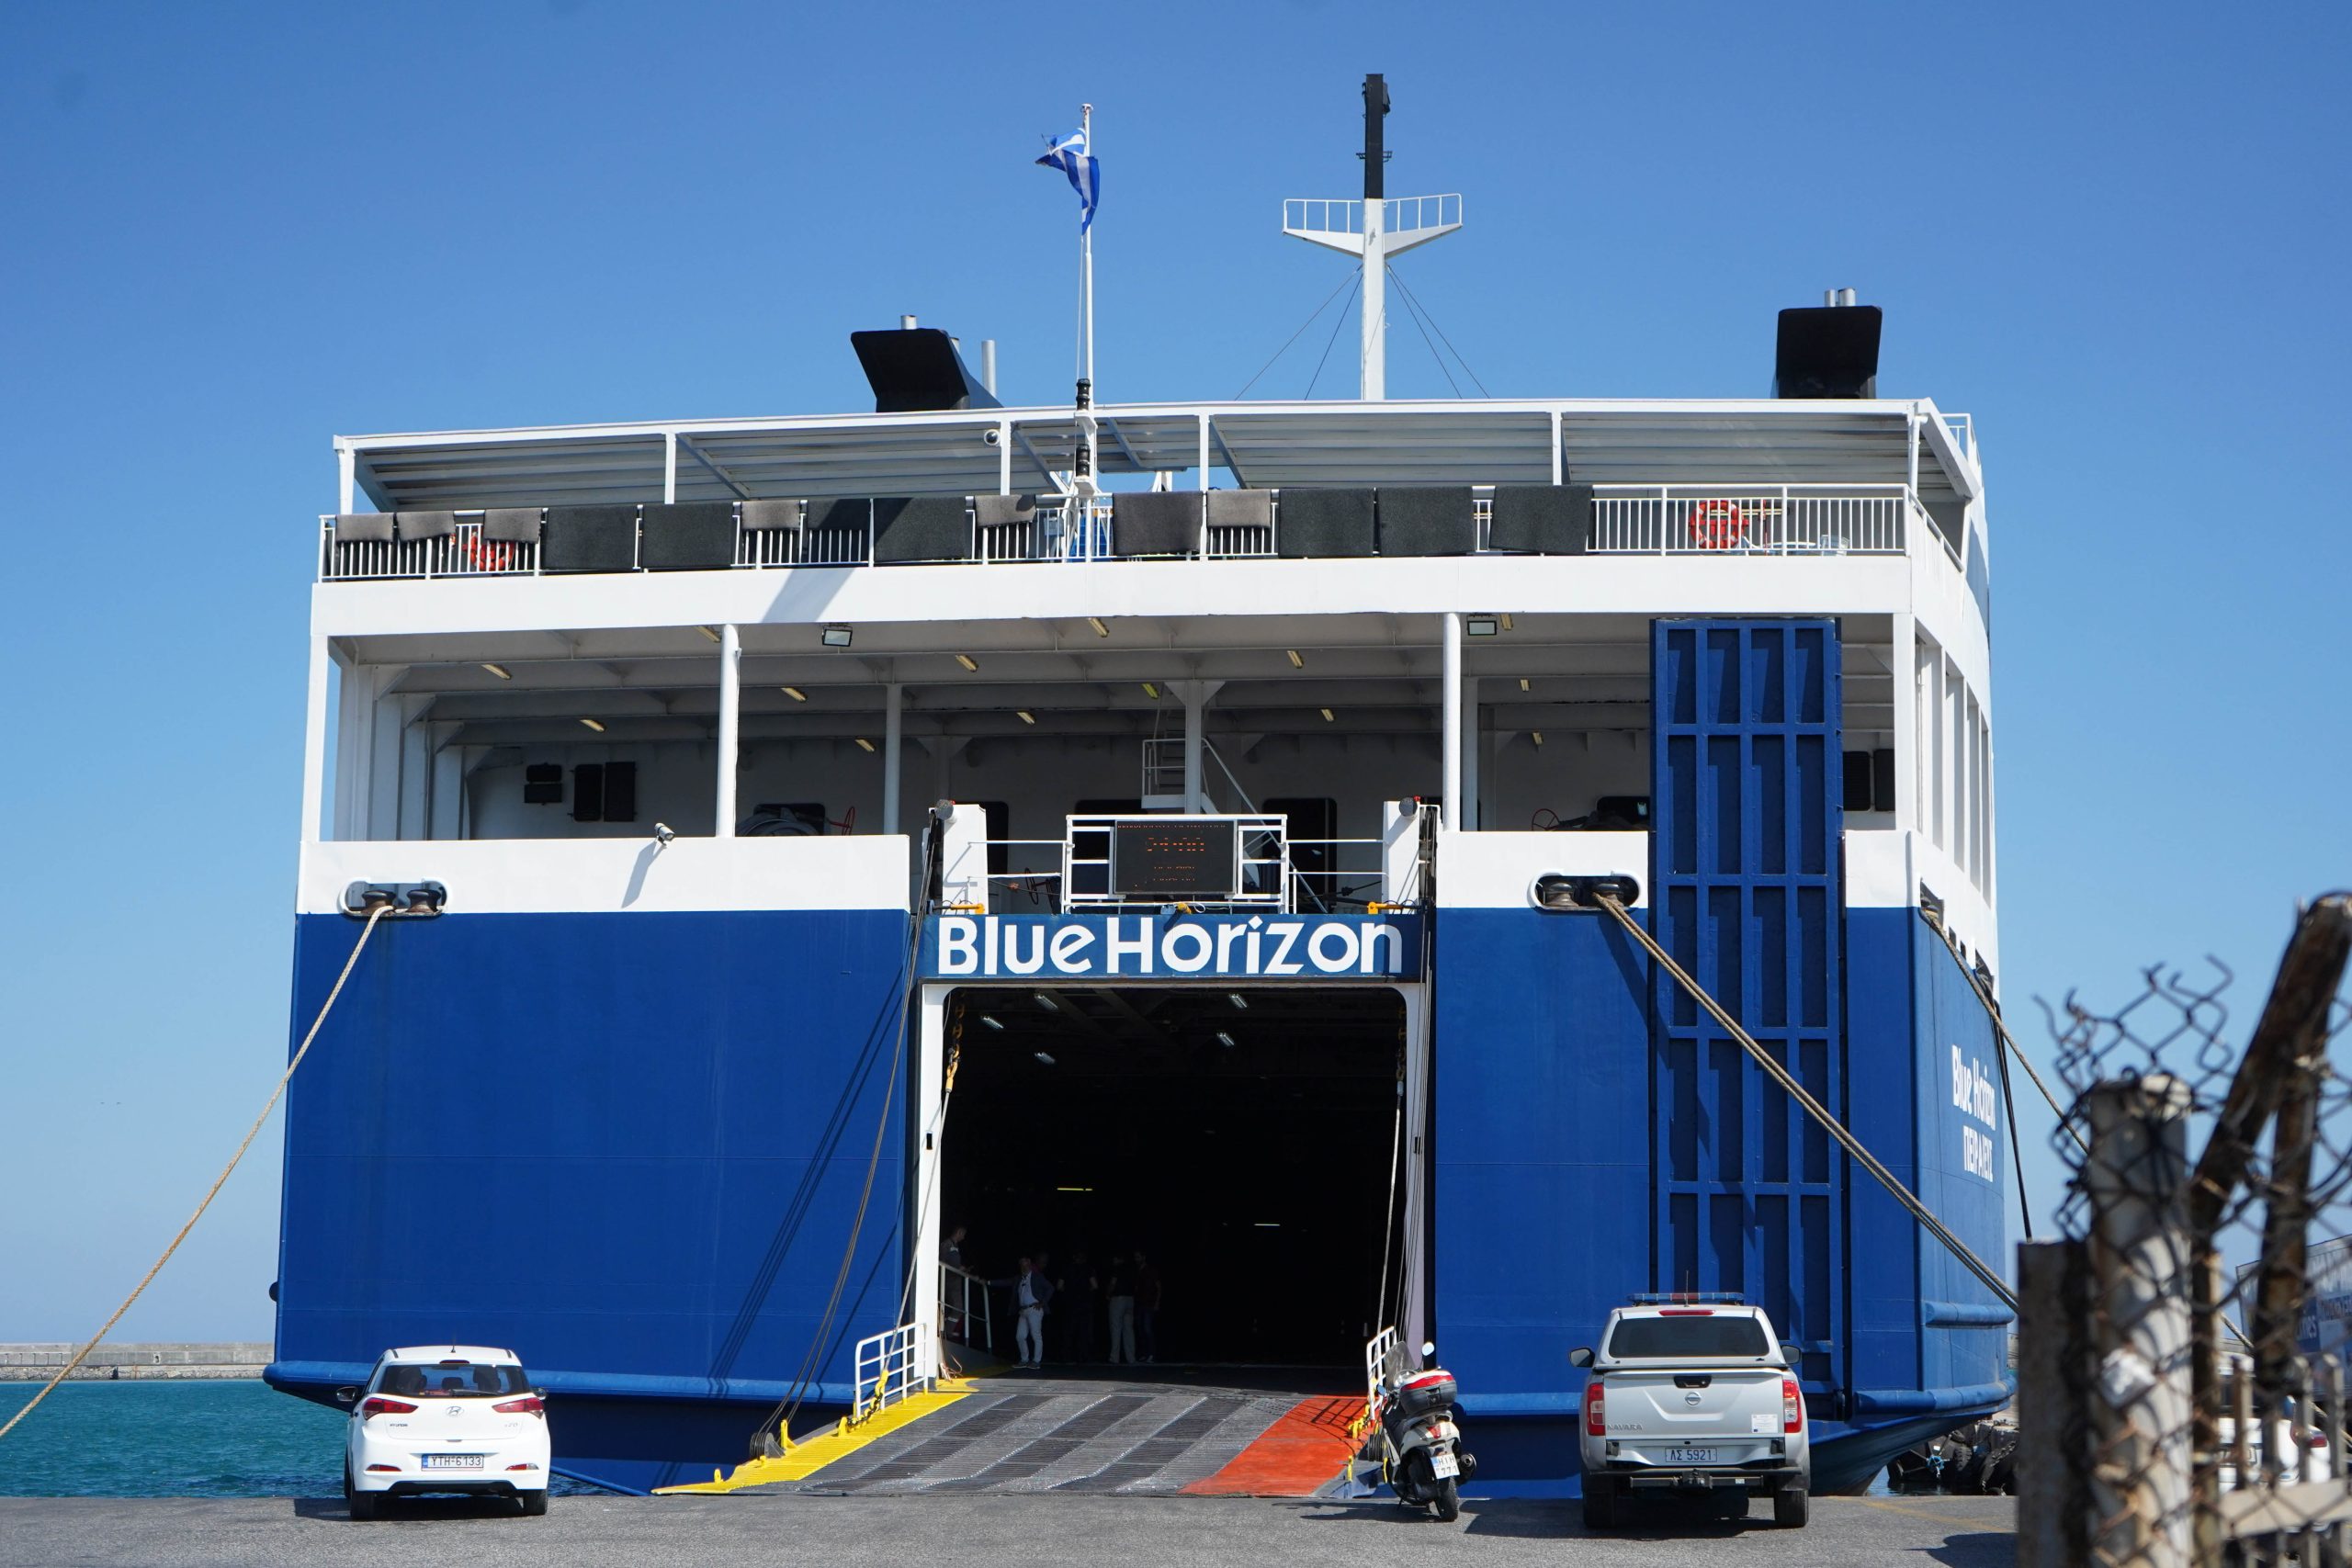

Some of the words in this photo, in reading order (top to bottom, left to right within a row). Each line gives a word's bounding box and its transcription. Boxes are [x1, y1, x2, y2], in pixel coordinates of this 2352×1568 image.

[939, 916, 1096, 975] Blue
[1107, 916, 1402, 975] Horizon
[1952, 1044, 1973, 1115] Blue
[1686, 1449, 1712, 1461] 5921
